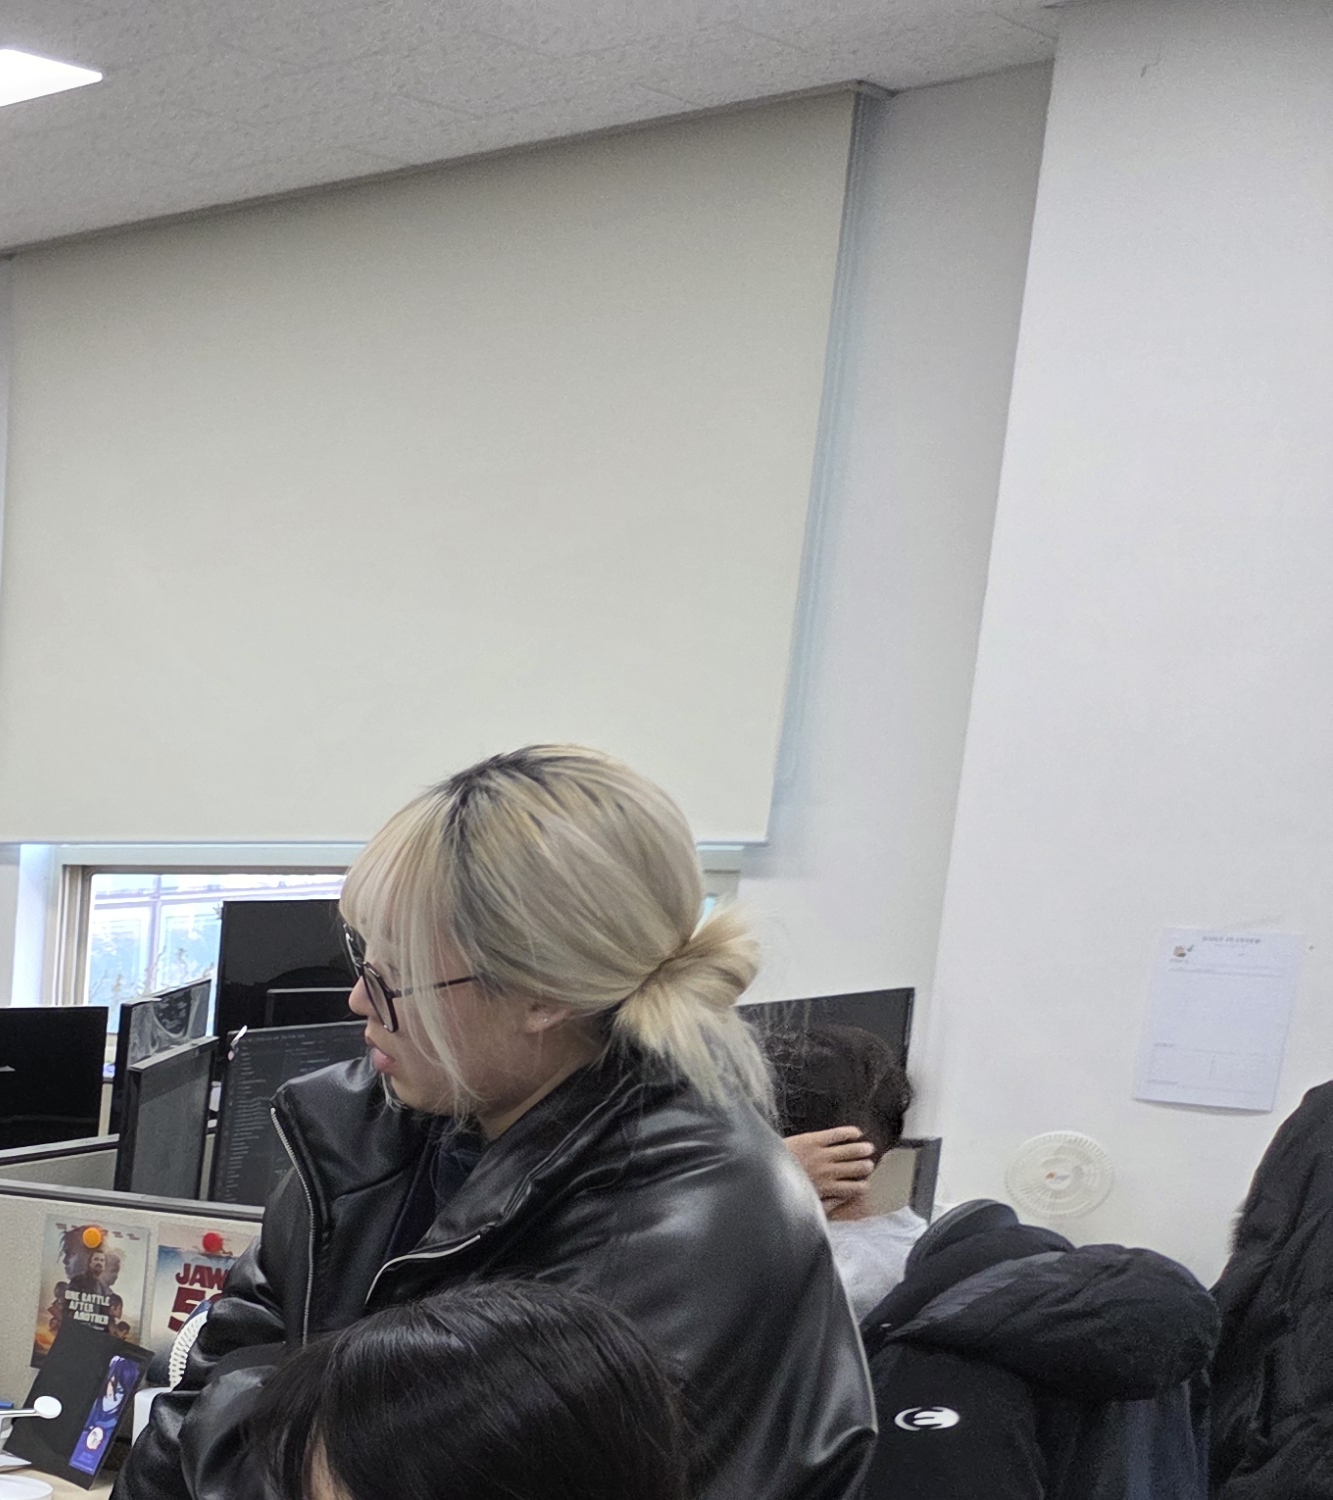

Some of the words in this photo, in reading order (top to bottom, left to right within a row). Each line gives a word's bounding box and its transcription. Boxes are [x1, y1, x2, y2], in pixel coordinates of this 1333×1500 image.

[175, 1263, 231, 1291] JAW
[64, 1290, 80, 1301] ONE
[81, 1292, 110, 1307] BATTLE
[69, 1300, 94, 1313] AFTER
[73, 1311, 109, 1326] ANOTHER
